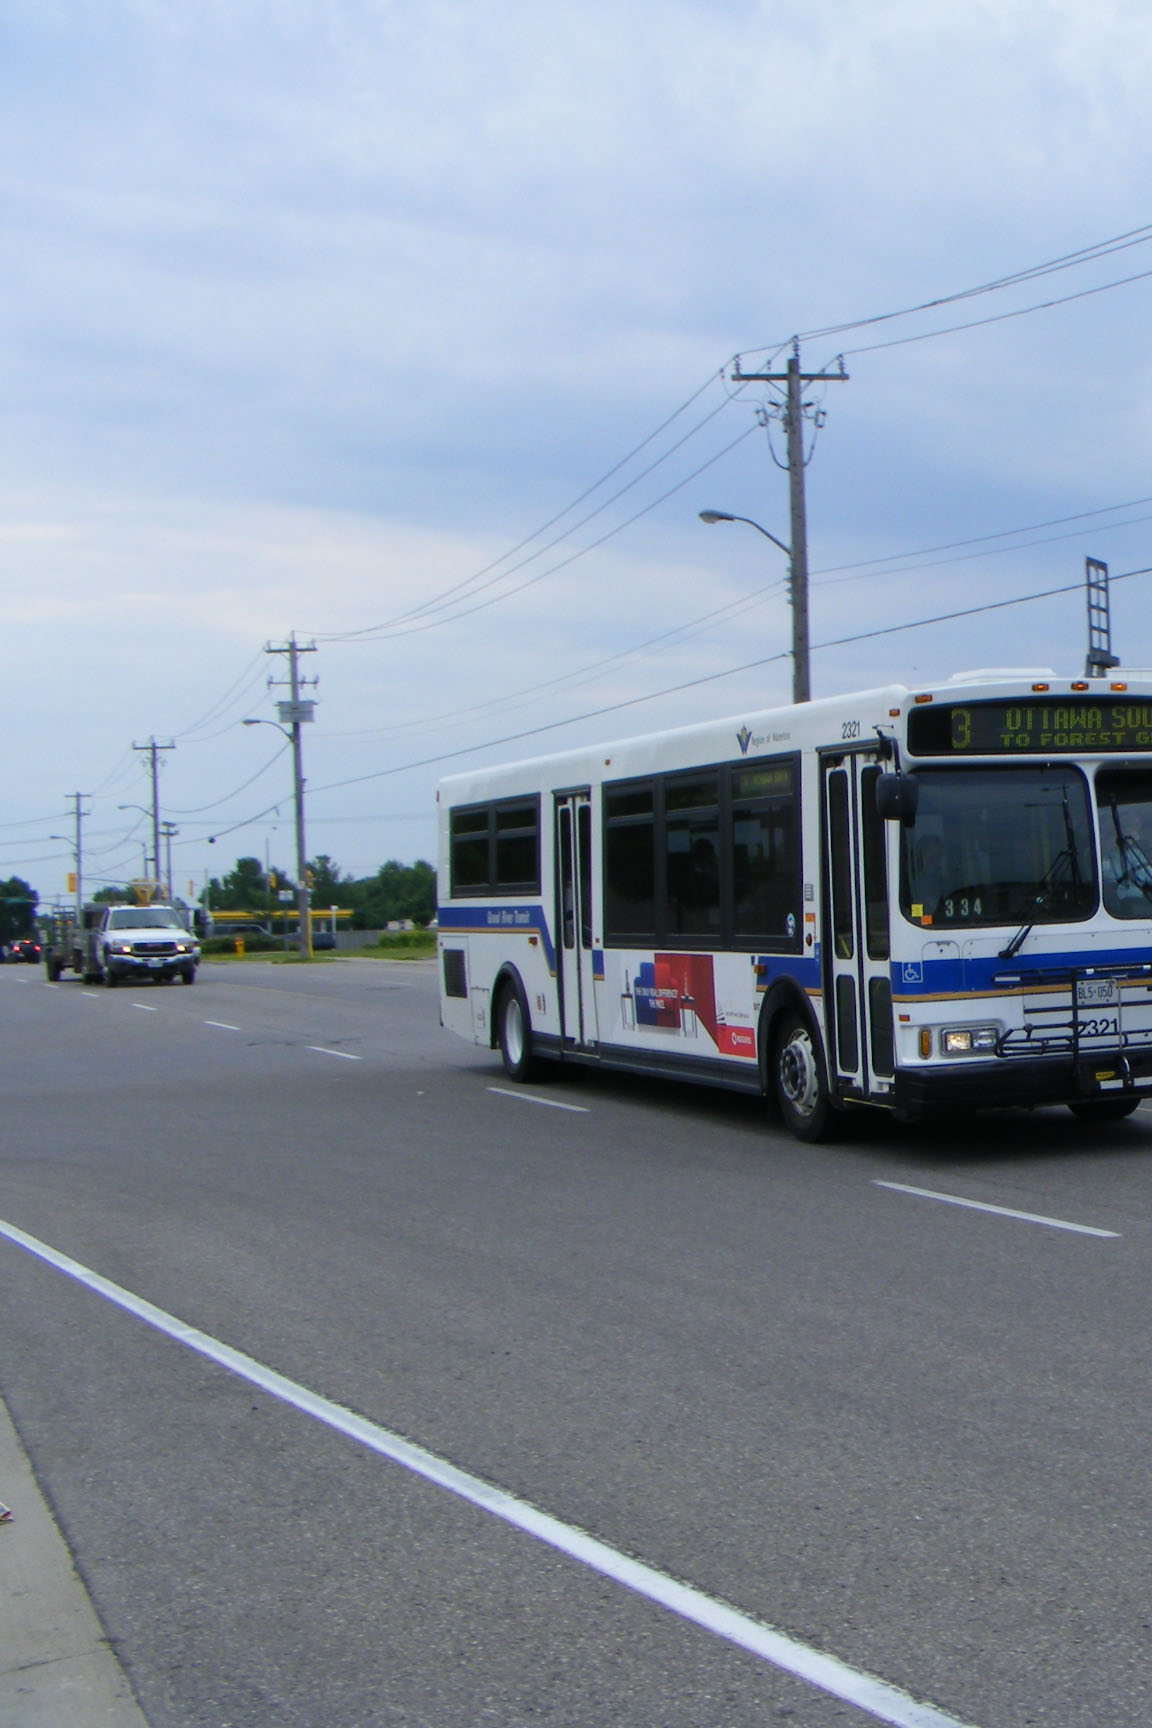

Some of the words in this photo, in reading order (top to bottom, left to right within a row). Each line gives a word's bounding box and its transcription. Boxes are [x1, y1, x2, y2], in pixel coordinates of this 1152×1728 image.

[951, 708, 972, 749] 3
[1006, 706, 1101, 730] OTTAWA
[842, 721, 860, 739] 2321
[1000, 734, 1030, 747] TO
[1040, 732, 1126, 746] FOREST
